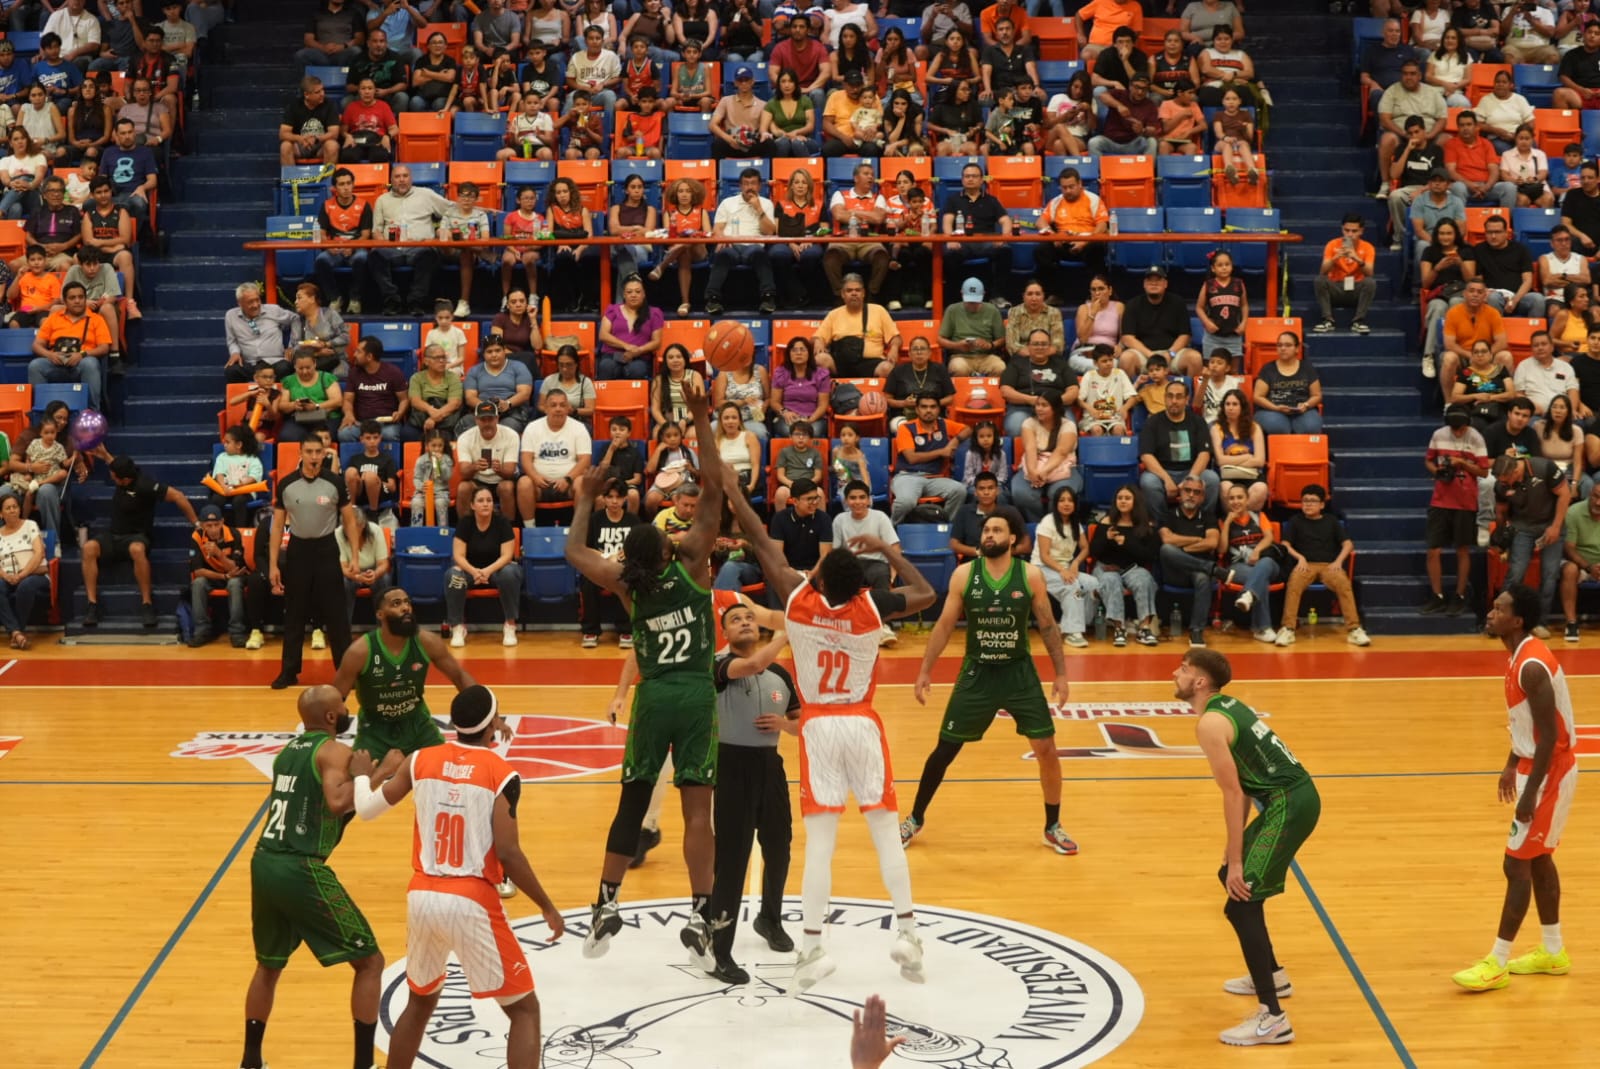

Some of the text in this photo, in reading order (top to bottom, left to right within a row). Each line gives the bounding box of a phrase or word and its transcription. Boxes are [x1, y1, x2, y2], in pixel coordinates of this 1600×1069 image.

[580, 66, 606, 80] BULLS
[358, 383, 388, 391] AeroNY
[538, 448, 569, 458] AERO
[598, 527, 631, 543] JUST
[979, 617, 1011, 625] MAREMI
[976, 630, 1018, 641] SANTOS
[657, 628, 692, 665] 22
[980, 640, 1016, 649] POTOSI
[818, 649, 851, 694] 22
[262, 798, 289, 841] 24
[435, 811, 466, 869] 30
